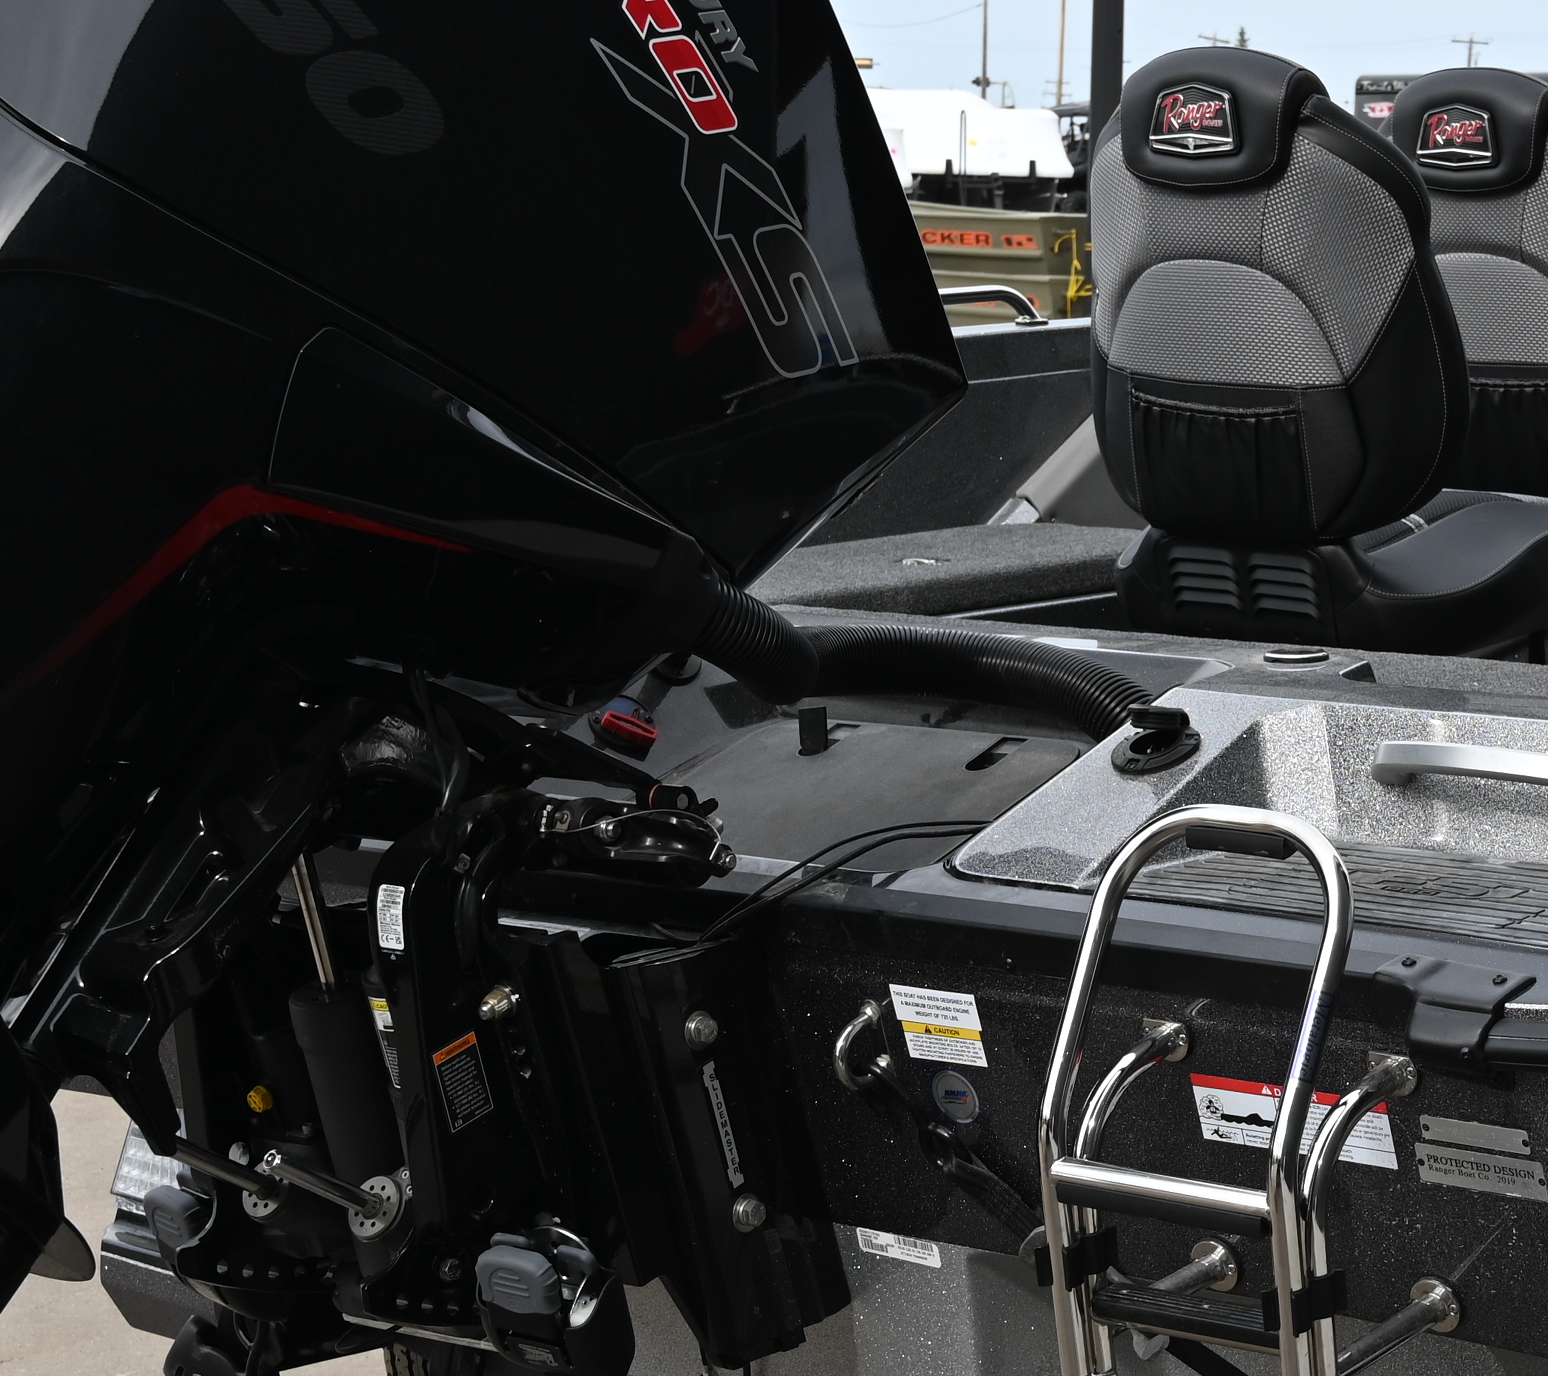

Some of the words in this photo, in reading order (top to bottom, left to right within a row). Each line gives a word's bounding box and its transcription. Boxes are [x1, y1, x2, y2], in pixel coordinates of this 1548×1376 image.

[1161, 94, 1225, 133] Ranger
[1427, 114, 1484, 148] Ranger
[590, 30, 859, 378] XS
[932, 1026, 960, 1036] CAUTION
[709, 1073, 740, 1176] SLIDEMASTER
[1426, 1153, 1491, 1173] PROTECTED
[1493, 1162, 1535, 1180] DESIGN
[1428, 1164, 1455, 1176] Ranger
[1458, 1169, 1472, 1180] Boat
[1478, 1172, 1492, 1181] Co.
